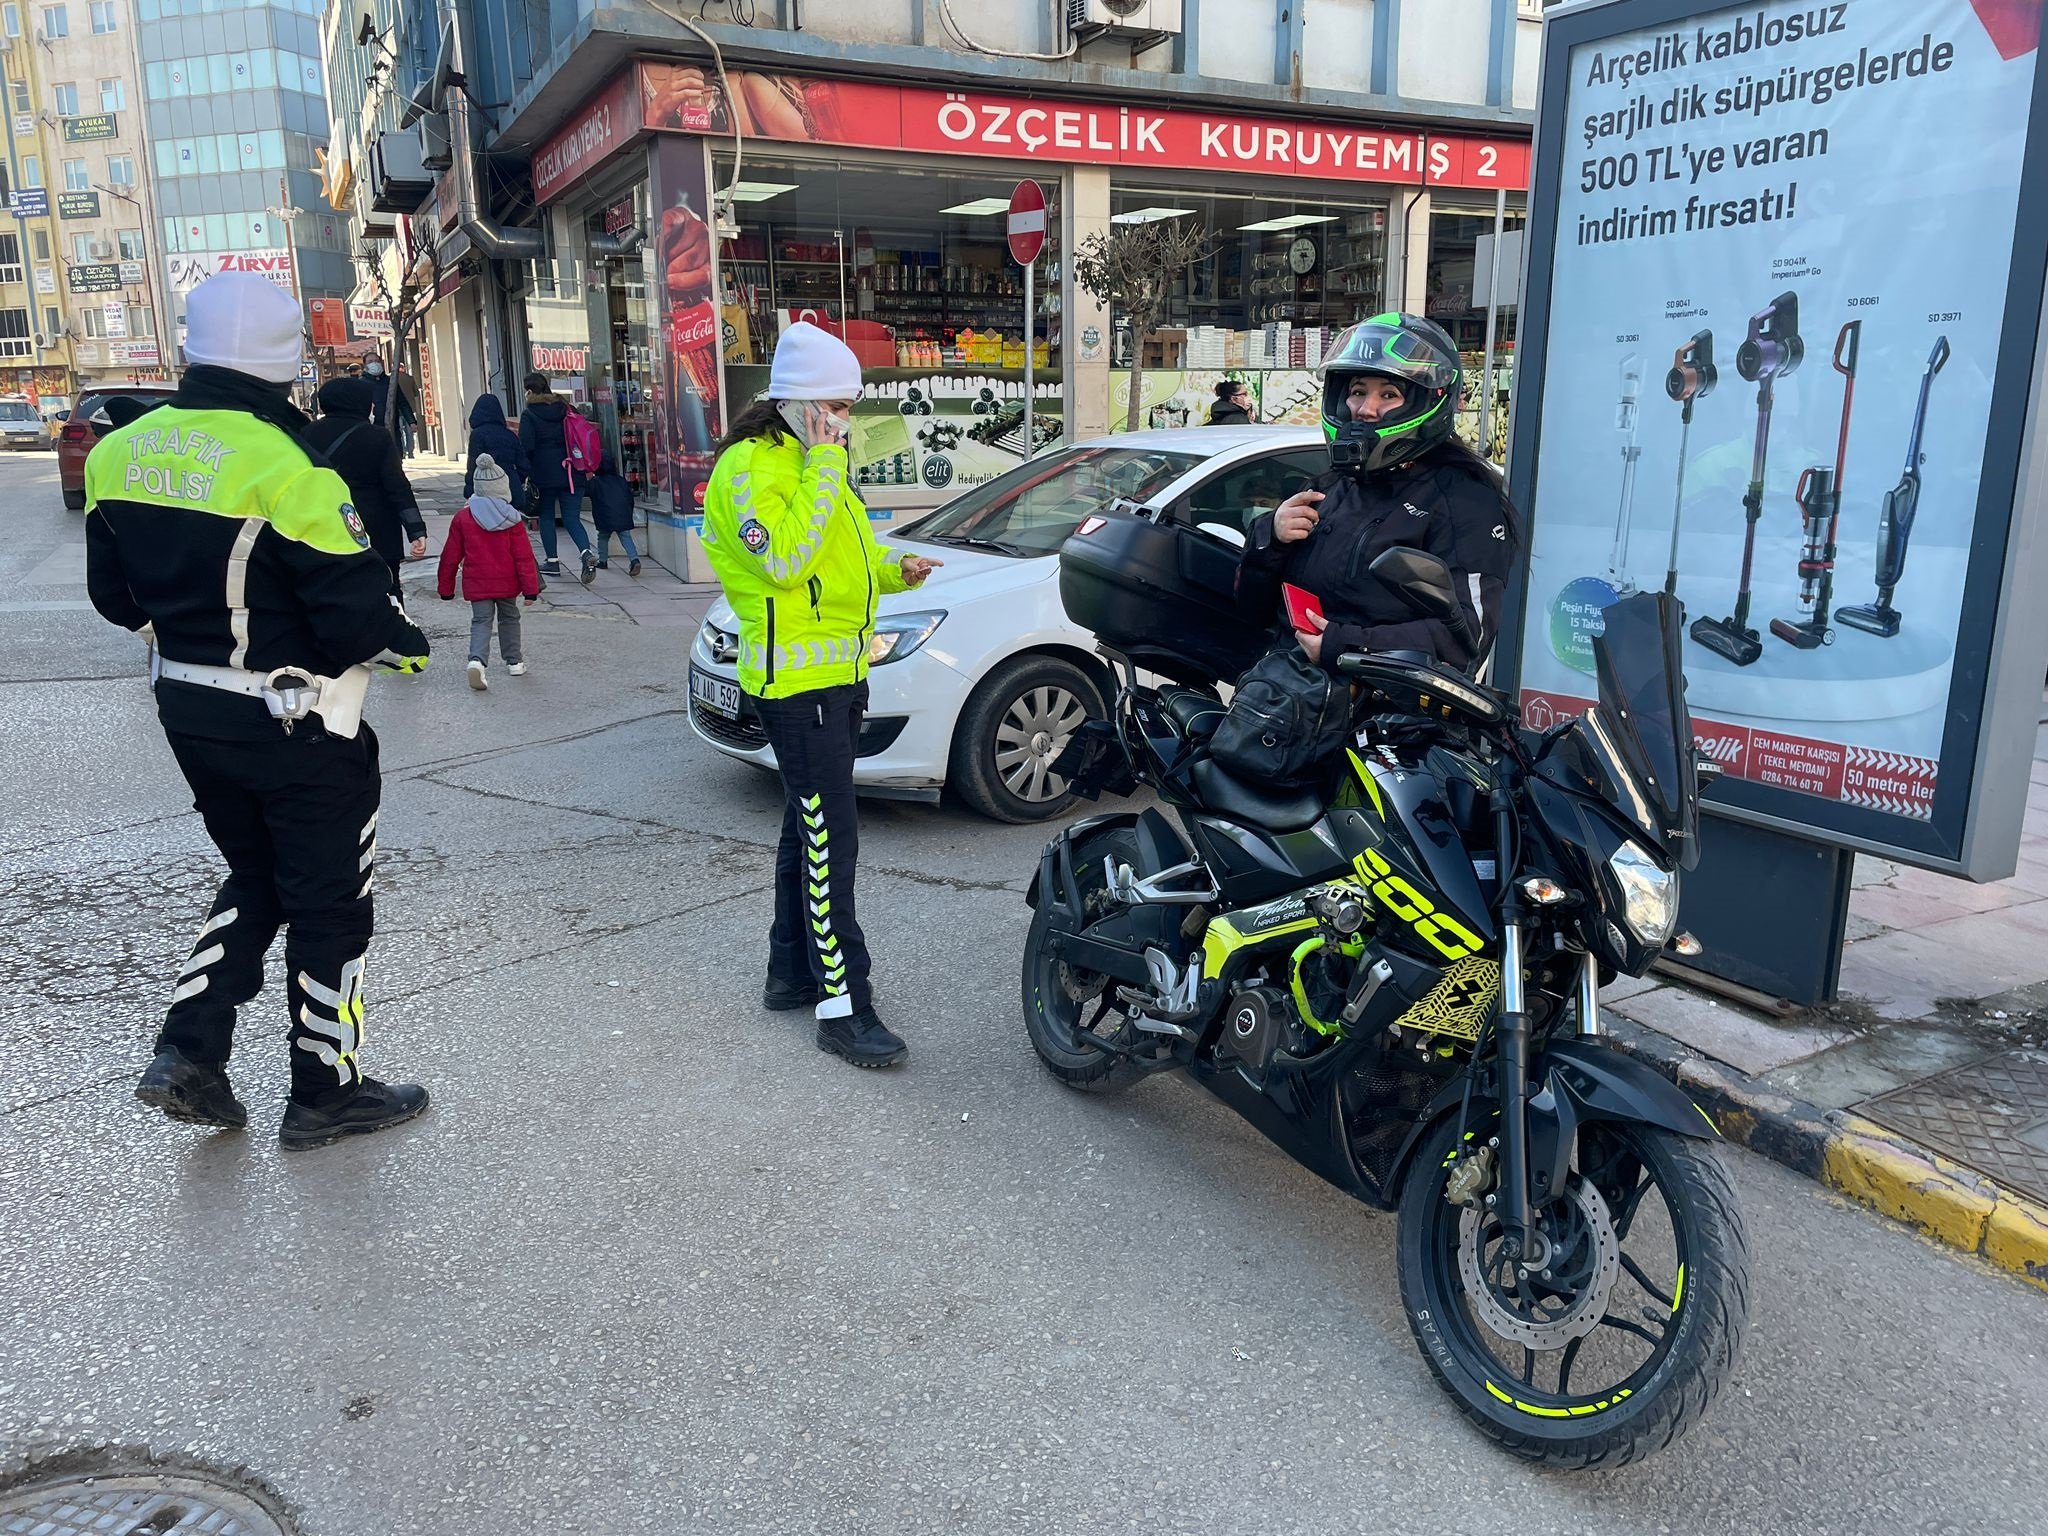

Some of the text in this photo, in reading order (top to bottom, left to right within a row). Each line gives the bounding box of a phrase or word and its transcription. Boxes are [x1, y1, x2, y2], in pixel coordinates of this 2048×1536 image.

[1586, 2, 1848, 90] Arçelik kablosuz
[1583, 33, 1955, 150] şarjlı dik süpürgelerde
[78, 117, 107, 127] AVUKAT
[535, 104, 612, 190] ÖZÇELİK KURUYEMİŞ 2
[937, 92, 1498, 180] ÖZÇELİK KURUYEMİŞ 2
[1580, 127, 1829, 194] 500 TL'ye varan
[1577, 182, 1798, 246] indirim fırsatı!
[217, 254, 291, 272] ZİRVE
[1772, 257, 1807, 268] SD 9041K
[1811, 267, 1821, 276] Go
[1666, 299, 1691, 309] SD 9041
[1699, 309, 1709, 317] Go
[1847, 296, 1880, 307] SD 6061
[1928, 311, 1962, 323] SD 3971
[1616, 335, 1624, 343] SD
[420, 346, 434, 424] KURU KAHVE
[127, 425, 237, 473] TRAFİK
[926, 461, 949, 478] elit
[124, 462, 215, 503] POLİSİ
[1560, 601, 1583, 615] Peşin
[1570, 617, 1580, 628] 15
[702, 678, 715, 703] AAD
[720, 684, 738, 711] 592
[1753, 737, 1840, 764] CEM MARKET KARŞISI
[1763, 754, 1787, 770] TEKEL
[1789, 760, 1825, 777] MEYDANI
[1761, 770, 1823, 793] 0284 714 60 70
[1847, 769, 1864, 786] 50
[1867, 775, 1908, 796] metre
[1257, 915, 1281, 928] NAKED
